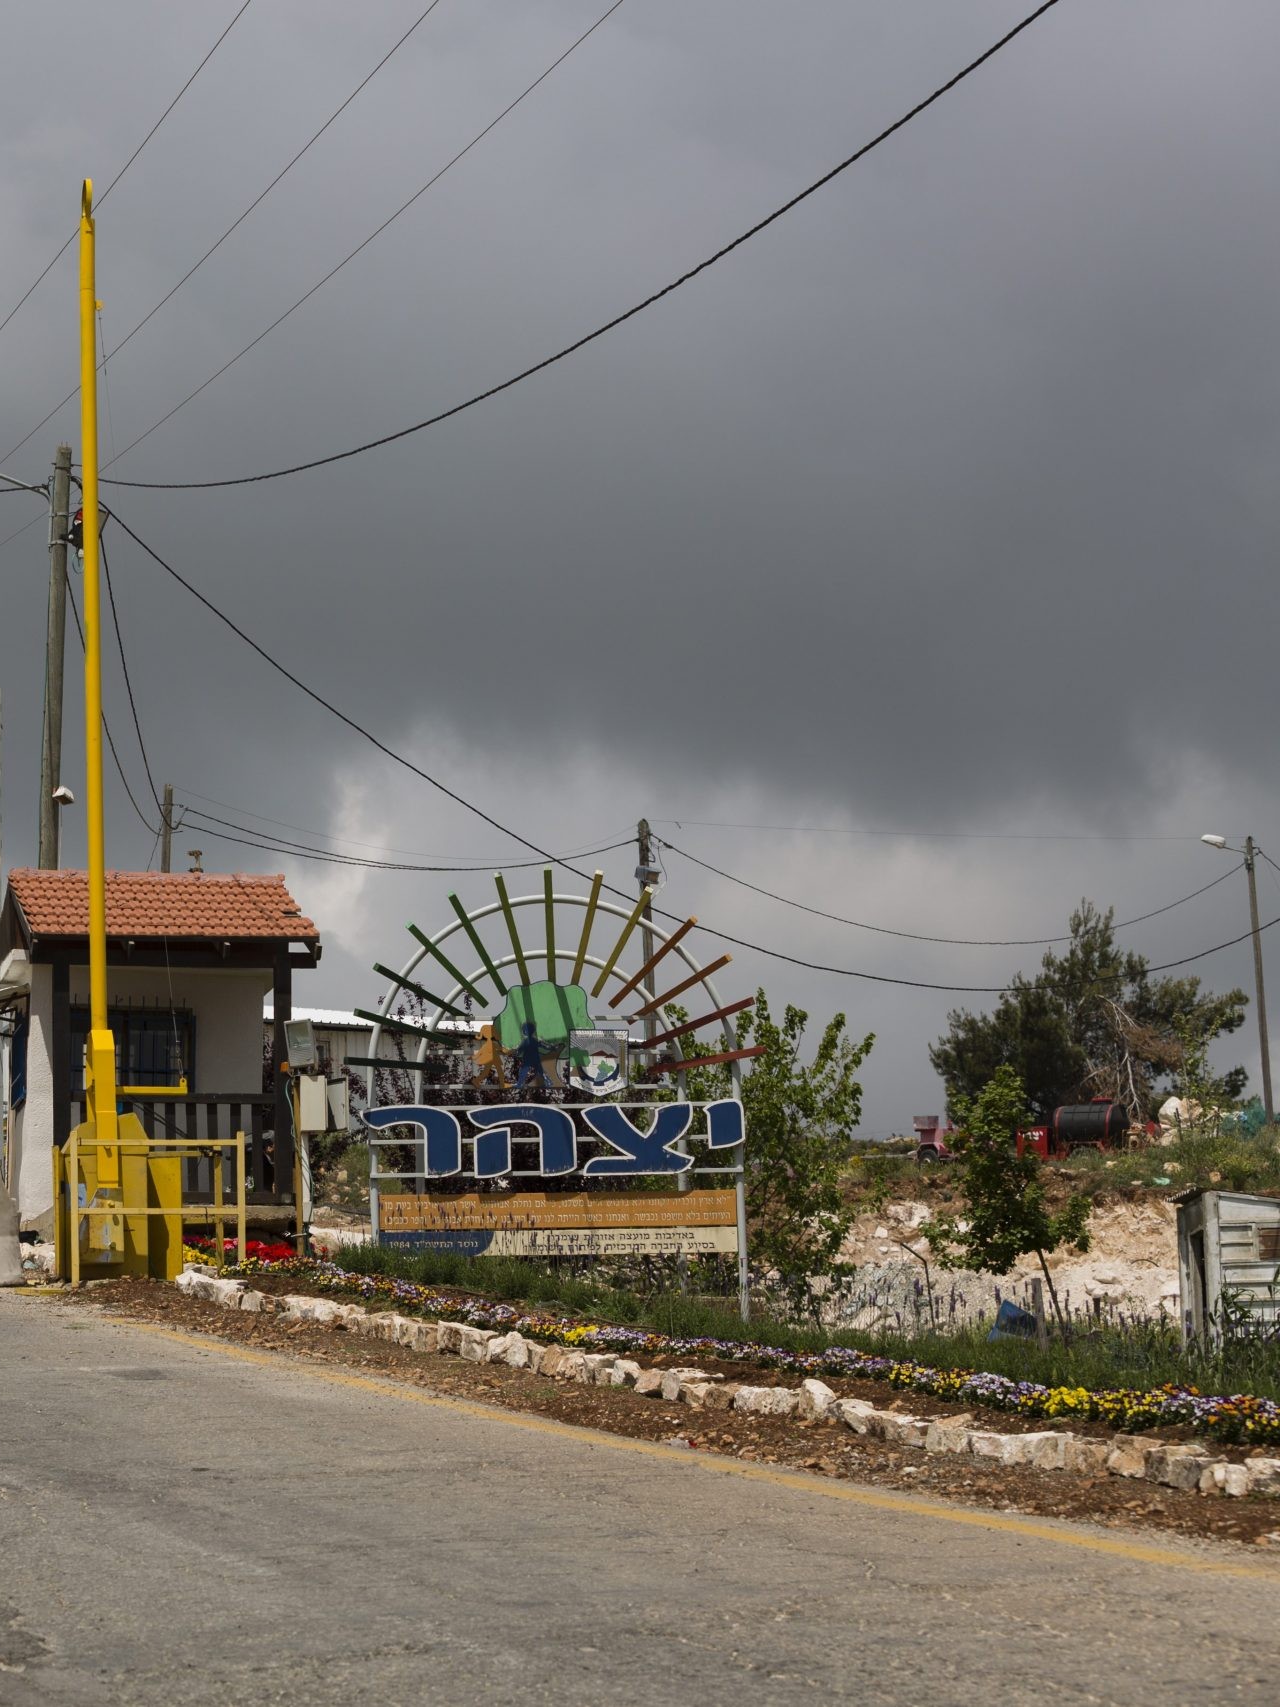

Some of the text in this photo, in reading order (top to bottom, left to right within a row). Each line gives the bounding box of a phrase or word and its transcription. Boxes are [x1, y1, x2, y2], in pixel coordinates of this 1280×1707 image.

[360, 1099, 745, 1179] יצהר
[384, 1202, 393, 1212] מן
[460, 1201, 476, 1209] אשר
[512, 1200, 532, 1208] נחלת
[535, 1199, 546, 1208] אם
[544, 1212, 555, 1223] לנו
[557, 1214, 580, 1223] הייתה
[581, 1213, 603, 1222] כאשר
[605, 1213, 629, 1222] ואנחנו
[660, 1211, 683, 1221] משפט
[686, 1210, 700, 1220] בלא
[583, 1233, 615, 1241] אזורית
[619, 1232, 650, 1241] מועצה
[655, 1232, 695, 1240] באדיבות
[389, 1241, 410, 1249] 1984
[604, 1243, 647, 1251] המרכזית
[651, 1242, 683, 1250] החברה
[687, 1242, 716, 1250] בסיוע
